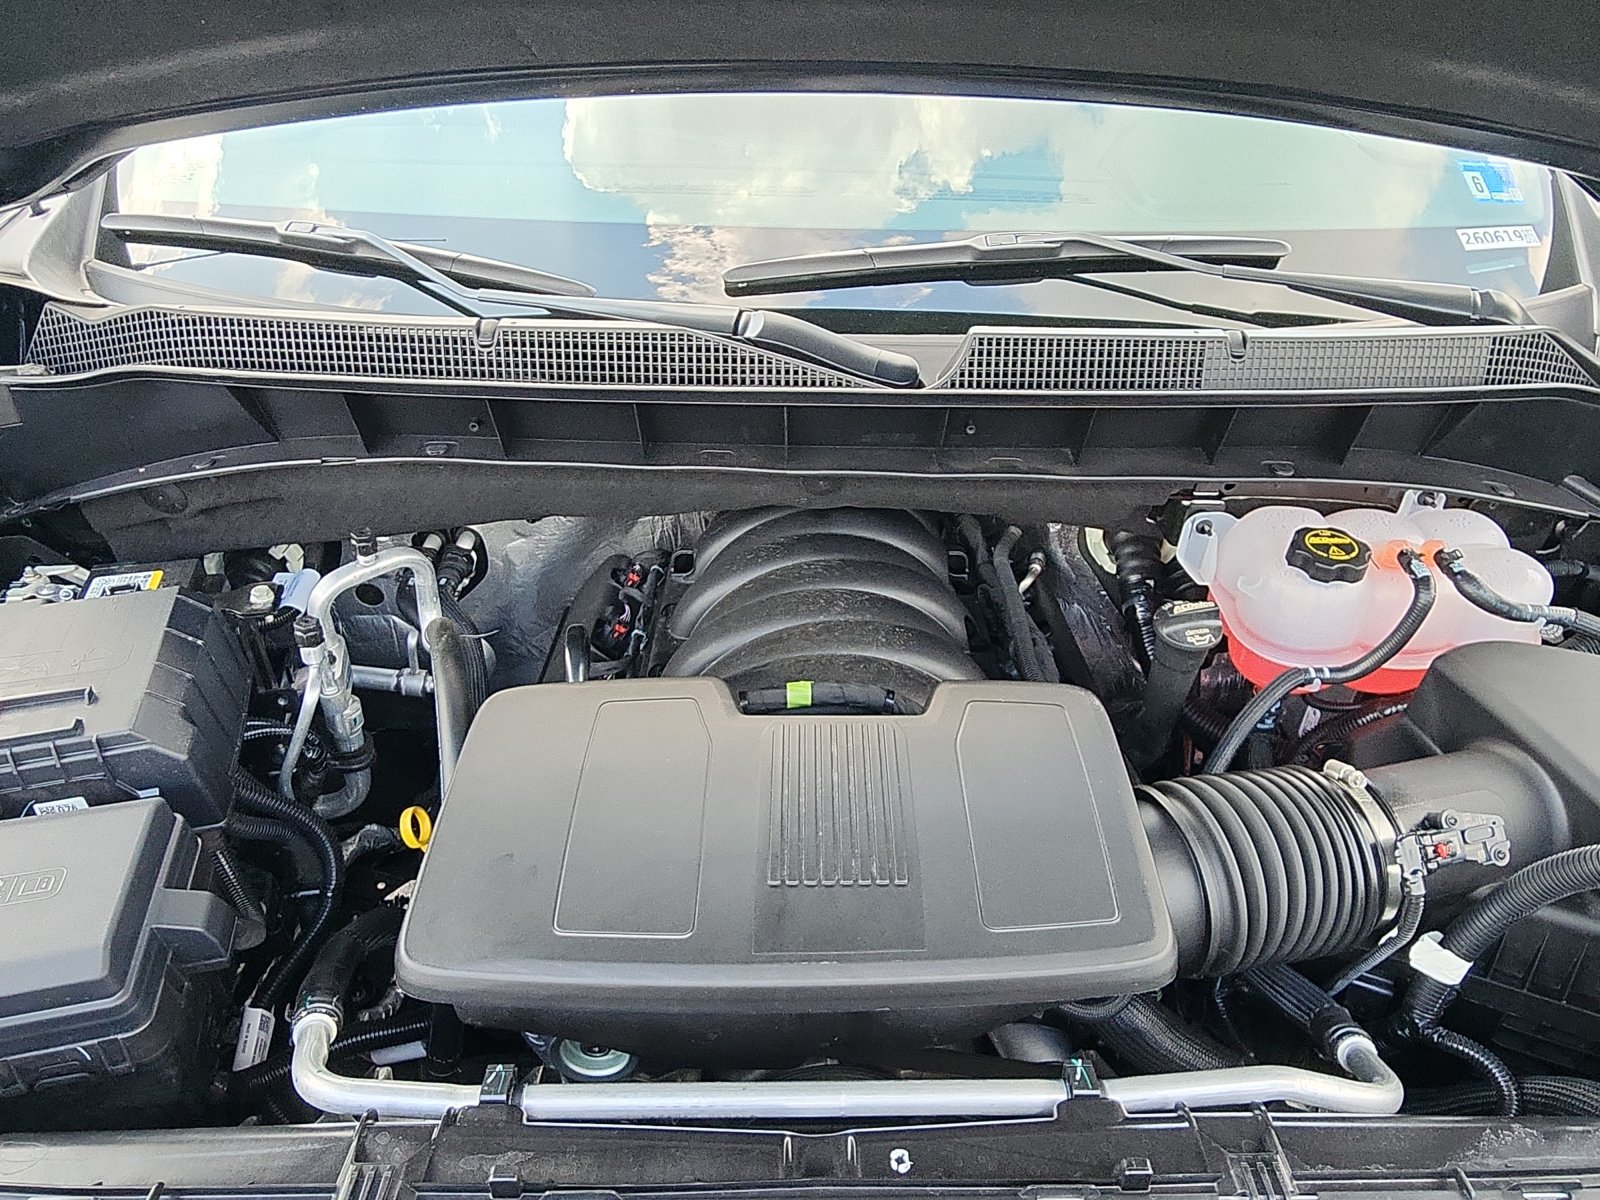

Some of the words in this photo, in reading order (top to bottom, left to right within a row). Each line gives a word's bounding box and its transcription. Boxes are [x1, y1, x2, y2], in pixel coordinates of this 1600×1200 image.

[1471, 176, 1485, 193] 6
[1460, 229, 1524, 245] 260619
[1173, 602, 1216, 614] ACDelco
